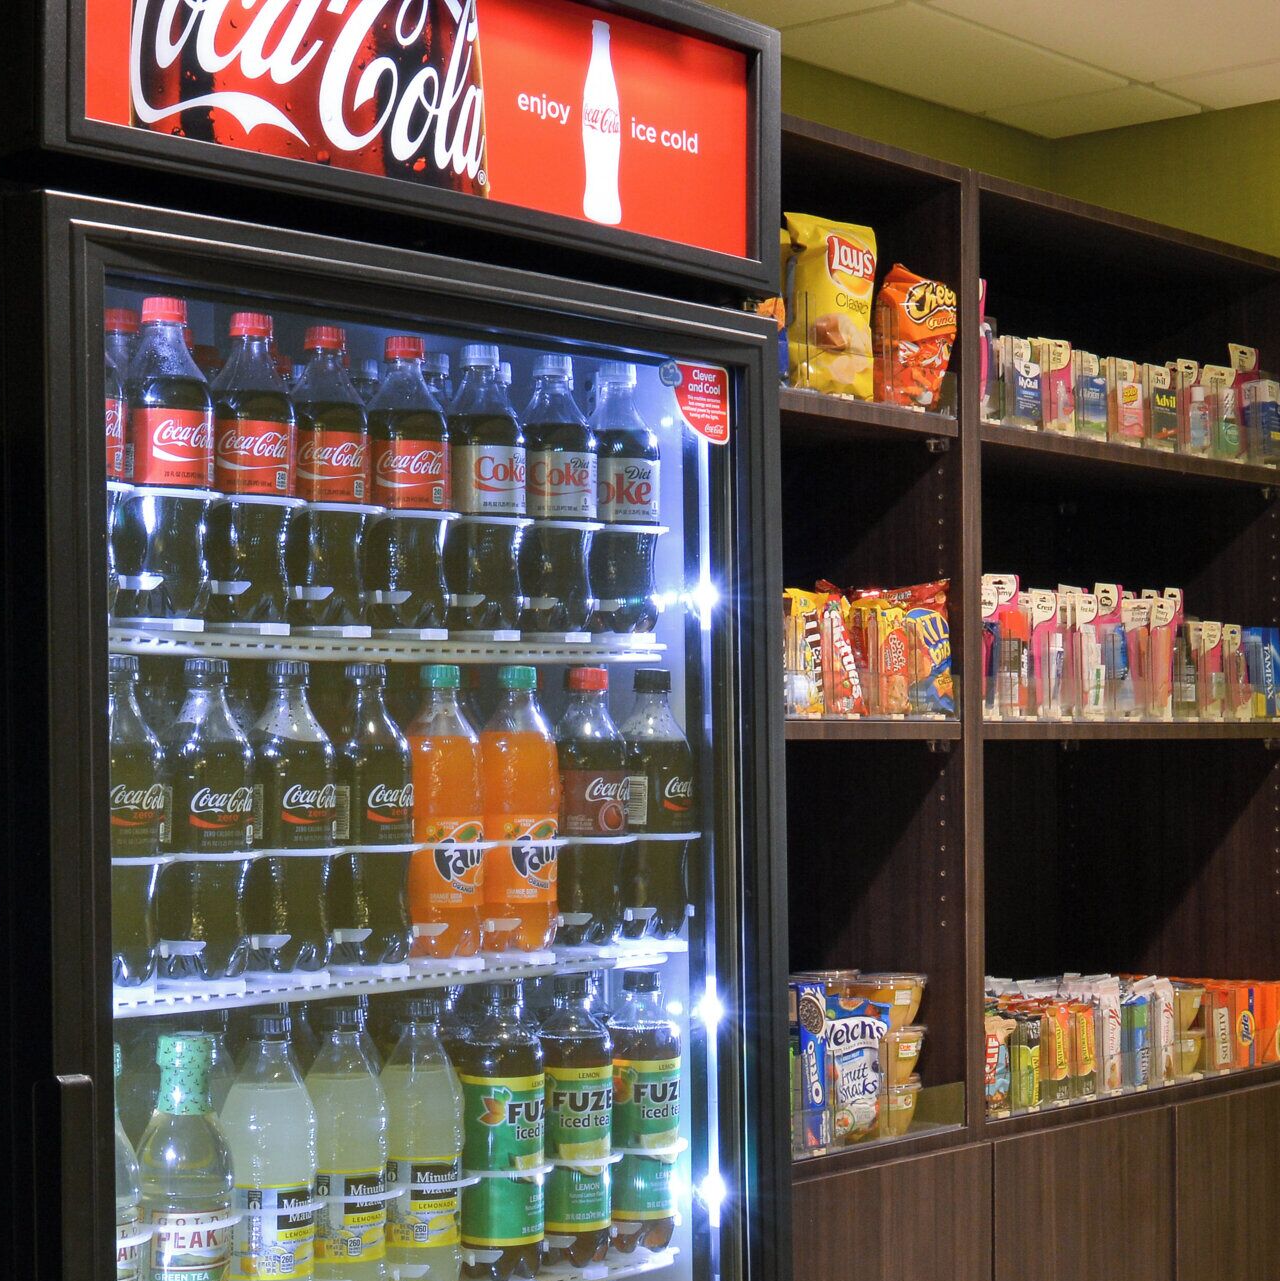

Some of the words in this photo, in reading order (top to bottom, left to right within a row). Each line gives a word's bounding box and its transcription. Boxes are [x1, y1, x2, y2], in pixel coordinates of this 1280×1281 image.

[517, 92, 571, 125] enjoy
[631, 117, 656, 143] ice
[660, 130, 699, 154] cold
[831, 236, 873, 278] Lay's
[835, 292, 869, 315] Classic
[692, 369, 716, 382] Clever
[688, 382, 703, 393] and
[704, 383, 720, 395] Cool
[1155, 393, 1176, 408] Advil
[220, 431, 288, 459] Coca-Cola
[301, 441, 365, 468] Coca-Cola
[376, 450, 443, 475] Coca-Cola
[528, 459, 589, 487] Coke
[625, 465, 651, 480] Diet
[599, 473, 652, 505] oke
[1263, 643, 1274, 700] TAMPAX
[190, 787, 252, 813] Coca-Cola
[826, 1019, 884, 1048] Welch's
[1218, 1011, 1228, 1060] ALTOIDS
[1241, 1013, 1252, 1043] Tide
[578, 1071, 600, 1079] LEMON
[807, 1040, 823, 1105] OREO
[552, 1090, 612, 1112] FUZE
[633, 1083, 680, 1104] FUZ
[559, 1114, 590, 1128] iced
[594, 1114, 610, 1127] tea
[641, 1104, 669, 1119] iced
[516, 1126, 540, 1140] iced
[416, 1171, 455, 1184] Minute
[575, 1182, 601, 1191] LEMON
[349, 1183, 385, 1196] Minute
[414, 1224, 427, 1233] 260
[156, 1230, 218, 1251] PEAK
[349, 1237, 360, 1248] 260
[282, 1254, 293, 1264] 260
[189, 1271, 210, 1281] TEA
